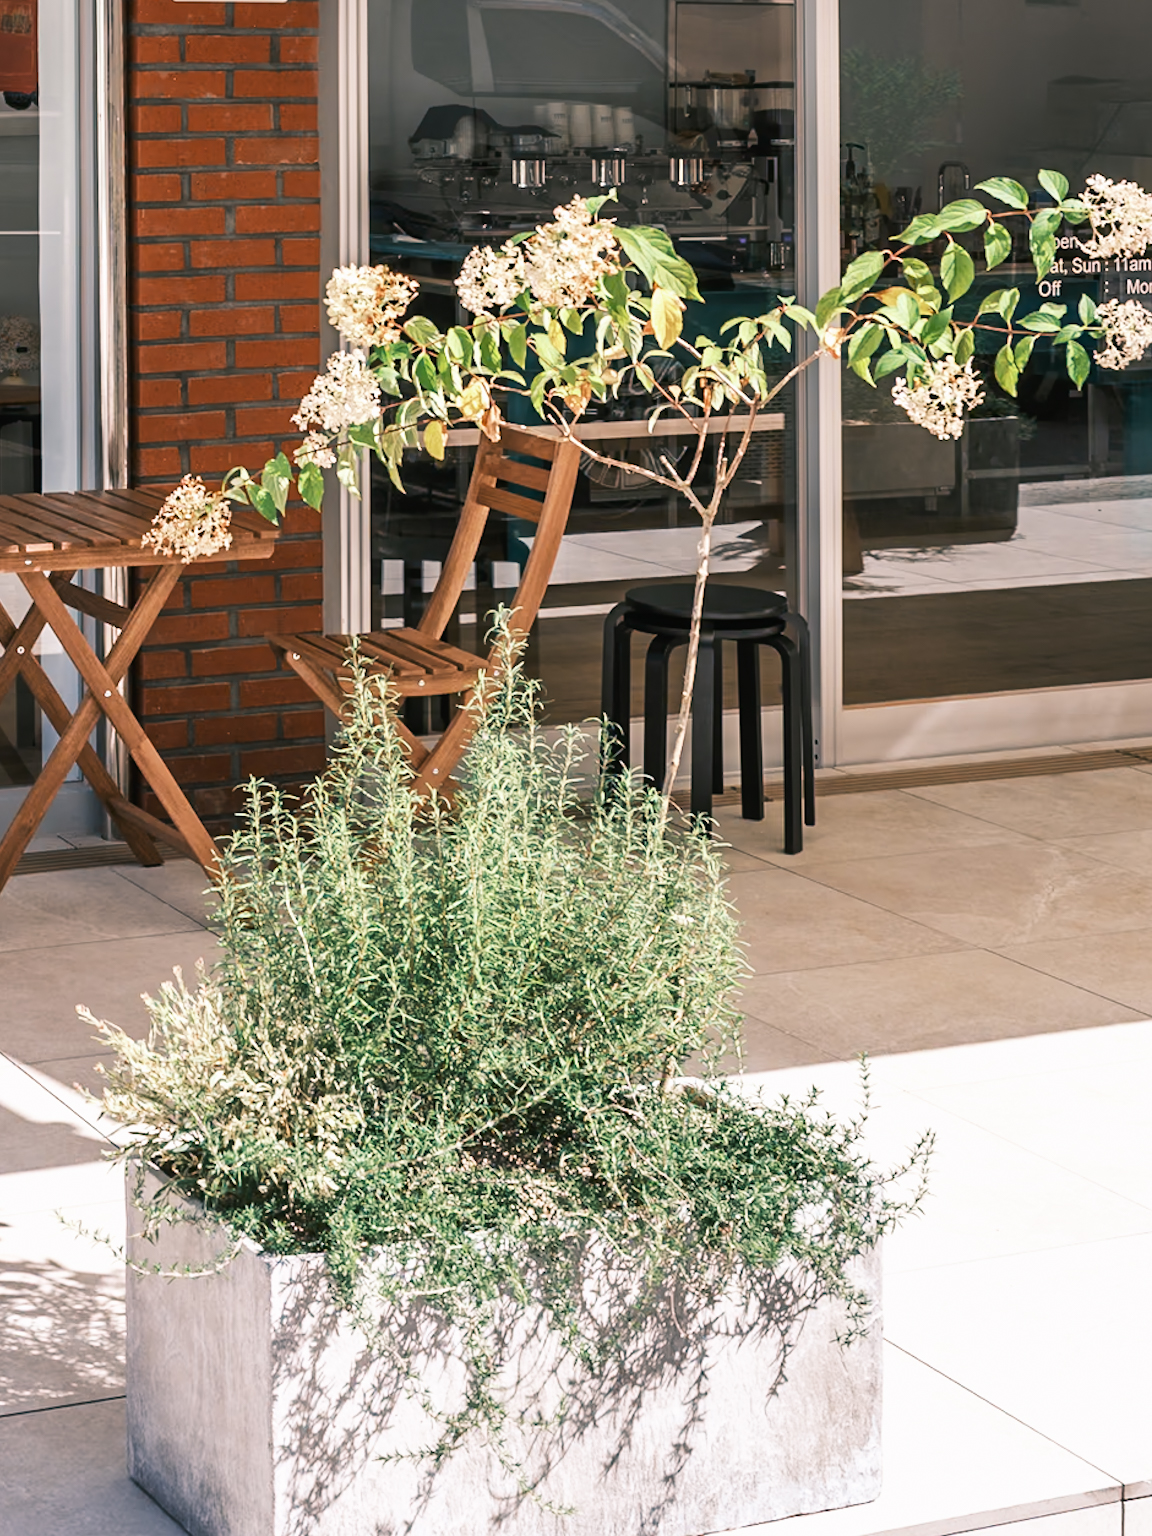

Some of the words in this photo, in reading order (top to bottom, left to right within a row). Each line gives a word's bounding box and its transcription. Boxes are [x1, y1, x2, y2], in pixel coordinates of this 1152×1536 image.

[1050, 258, 1068, 275] at,
[1071, 257, 1101, 274] Sun
[1113, 256, 1152, 272] 11am
[1038, 280, 1062, 298] Off
